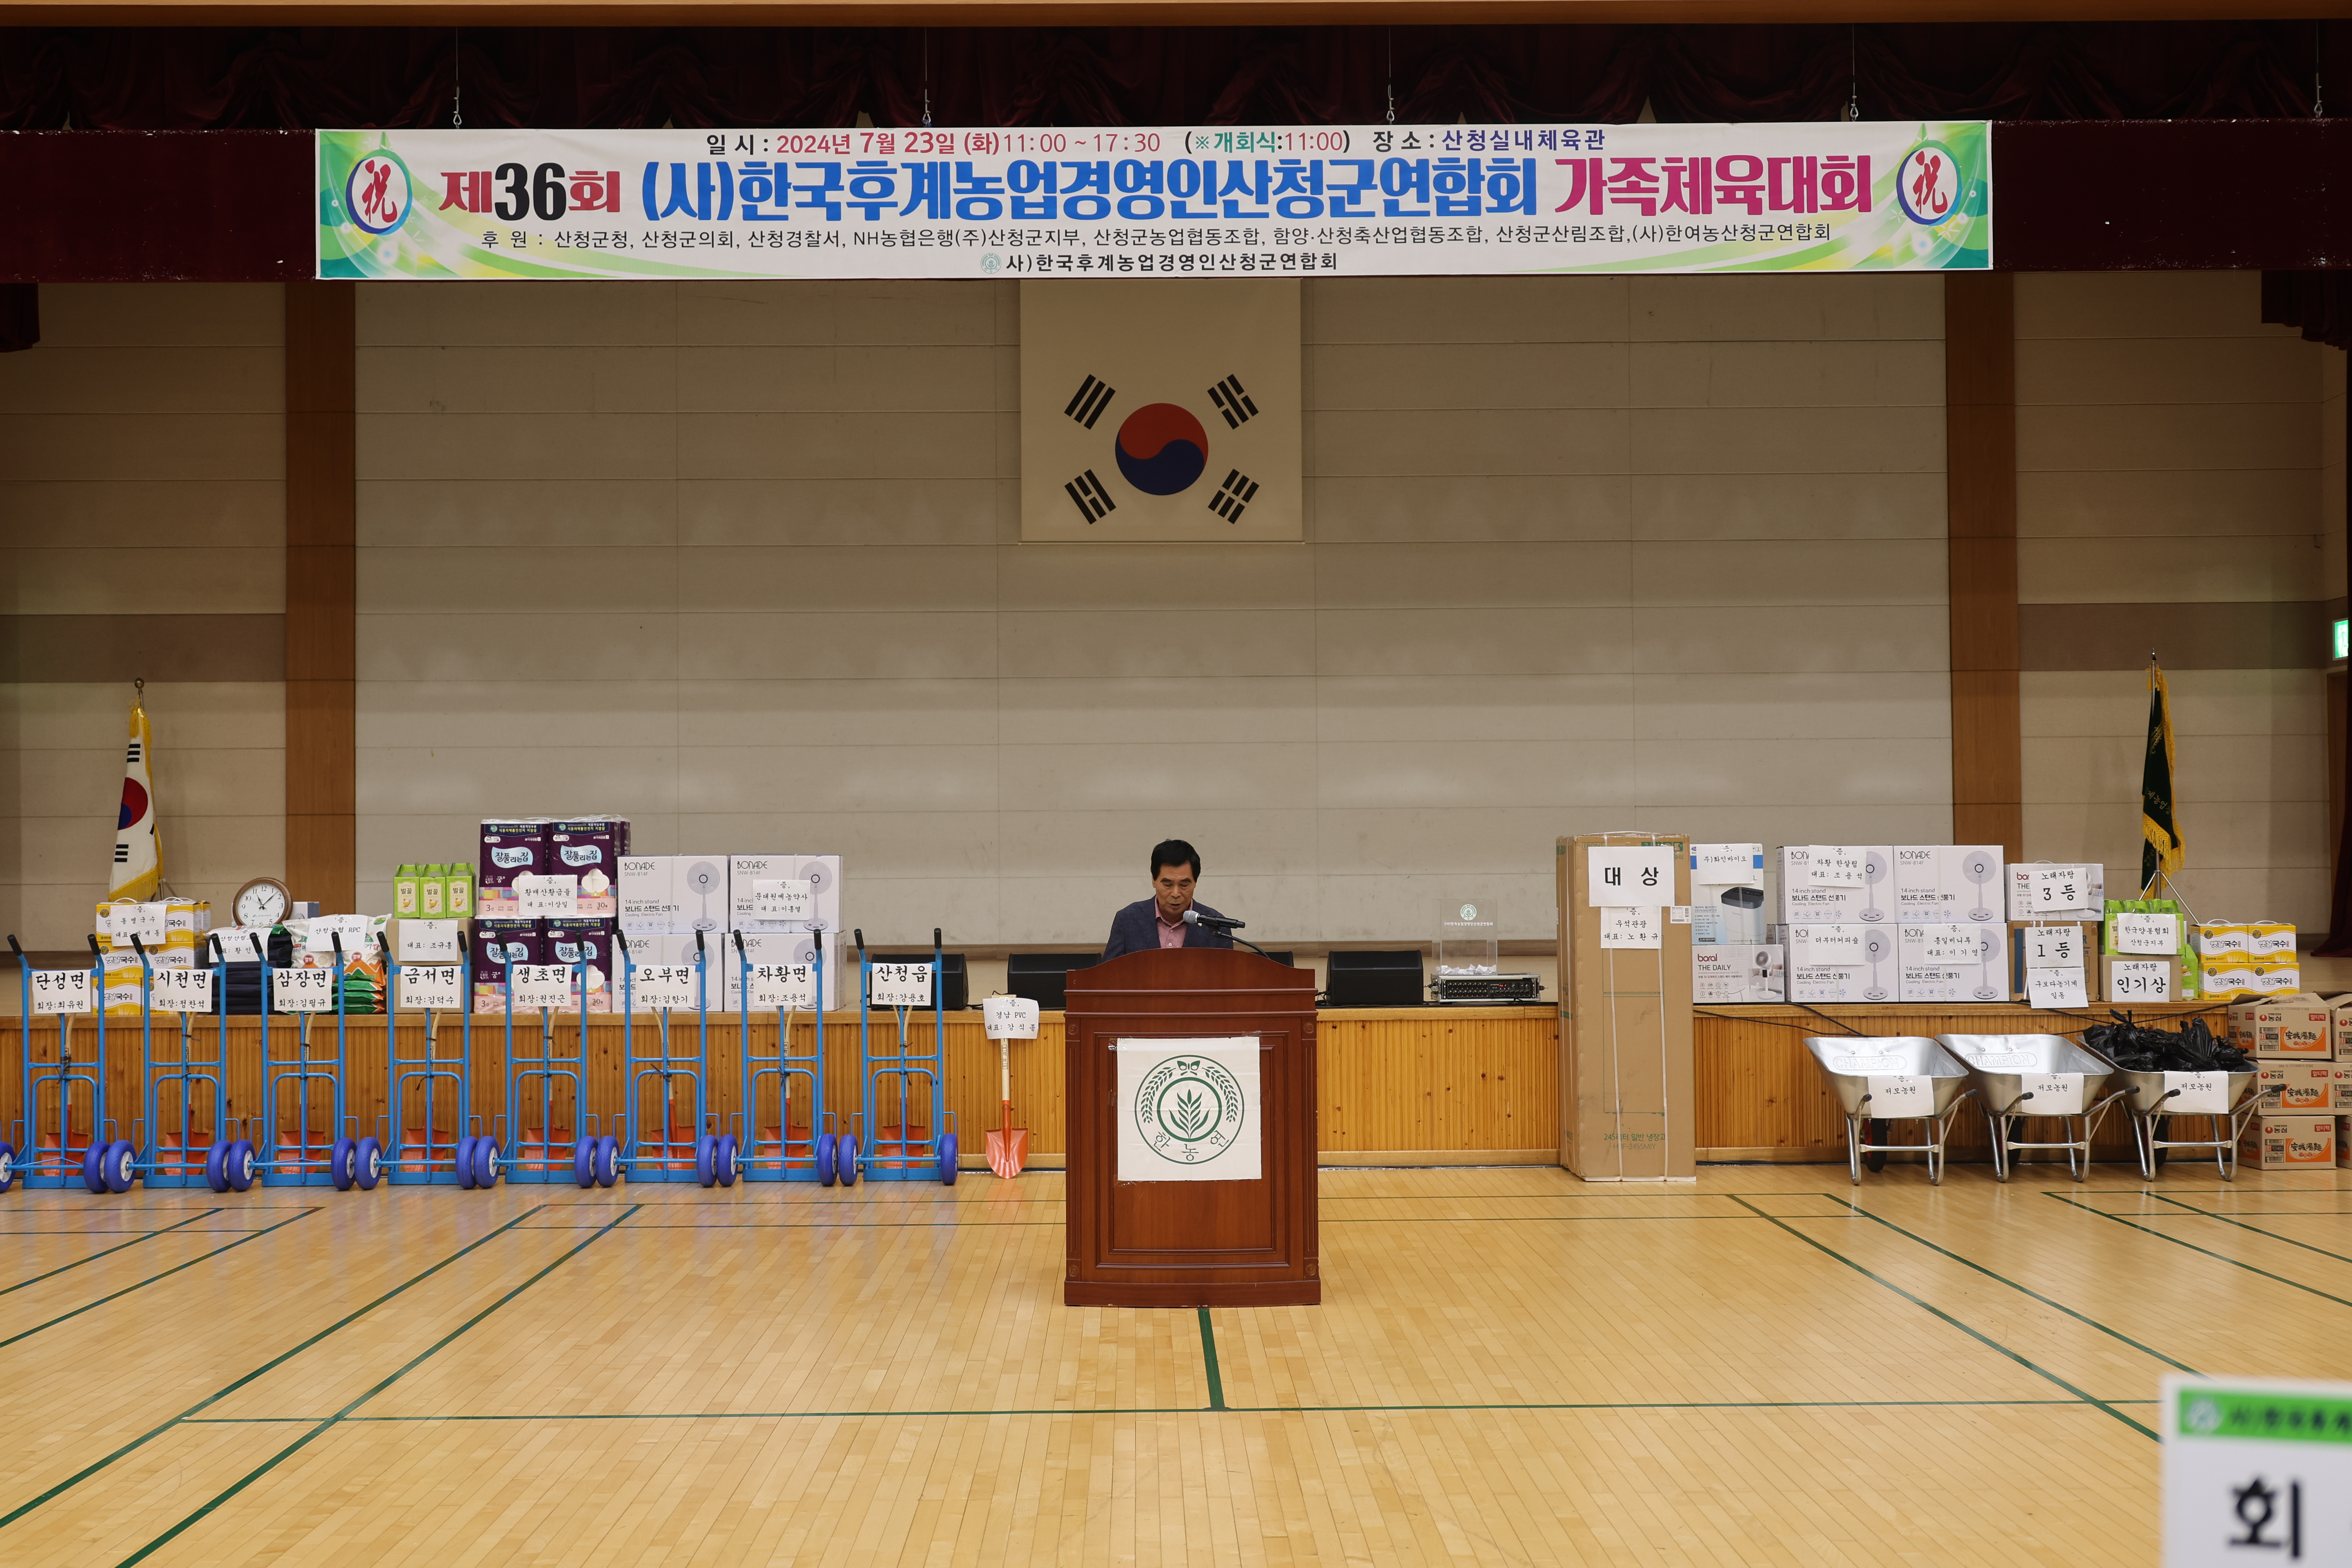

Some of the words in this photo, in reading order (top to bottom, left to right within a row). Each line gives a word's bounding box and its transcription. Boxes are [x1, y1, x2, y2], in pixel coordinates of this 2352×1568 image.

[777, 134, 850, 154] 2024년
[860, 132, 895, 154] 7월
[904, 132, 954, 154] 23일
[1442, 130, 1605, 151] 산청실내체육관
[439, 163, 620, 221] 제36회
[642, 158, 1537, 222] (사)한국후계농업경영인산청군연합회
[1555, 155, 1871, 216] 가족체육대회
[555, 231, 633, 249] 산청군청,
[642, 231, 739, 249] 산청군의회,
[748, 230, 845, 248] 산청경찰서,
[1094, 228, 1265, 246] 산청군농업협동조합,
[1006, 253, 1336, 272] 사)한국후계농업경영인산청군연합회
[495, 852, 528, 864] 잘풀리는집
[564, 850, 597, 862] 잘풀리는집
[624, 862, 655, 870] BONADE
[737, 861, 768, 869] BONADE
[2042, 870, 2074, 880] 노래자랑
[2038, 928, 2071, 936] 노래자랑
[2125, 926, 2168, 935] 한국양봉협회
[1698, 953, 1717, 962] boral
[517, 967, 565, 983] 생초면
[639, 967, 689, 984] 오부면
[757, 965, 806, 982] 차황면
[876, 965, 927, 982] 산청읍
[2124, 963, 2157, 971] 노래자랑
[36, 972, 83, 990] 단성면
[157, 971, 206, 989] 시천면
[276, 970, 325, 987] 삼장면
[405, 968, 454, 985] 금서면
[2118, 977, 2166, 993] 인기상
[2228, 1476, 2302, 1561] 회
